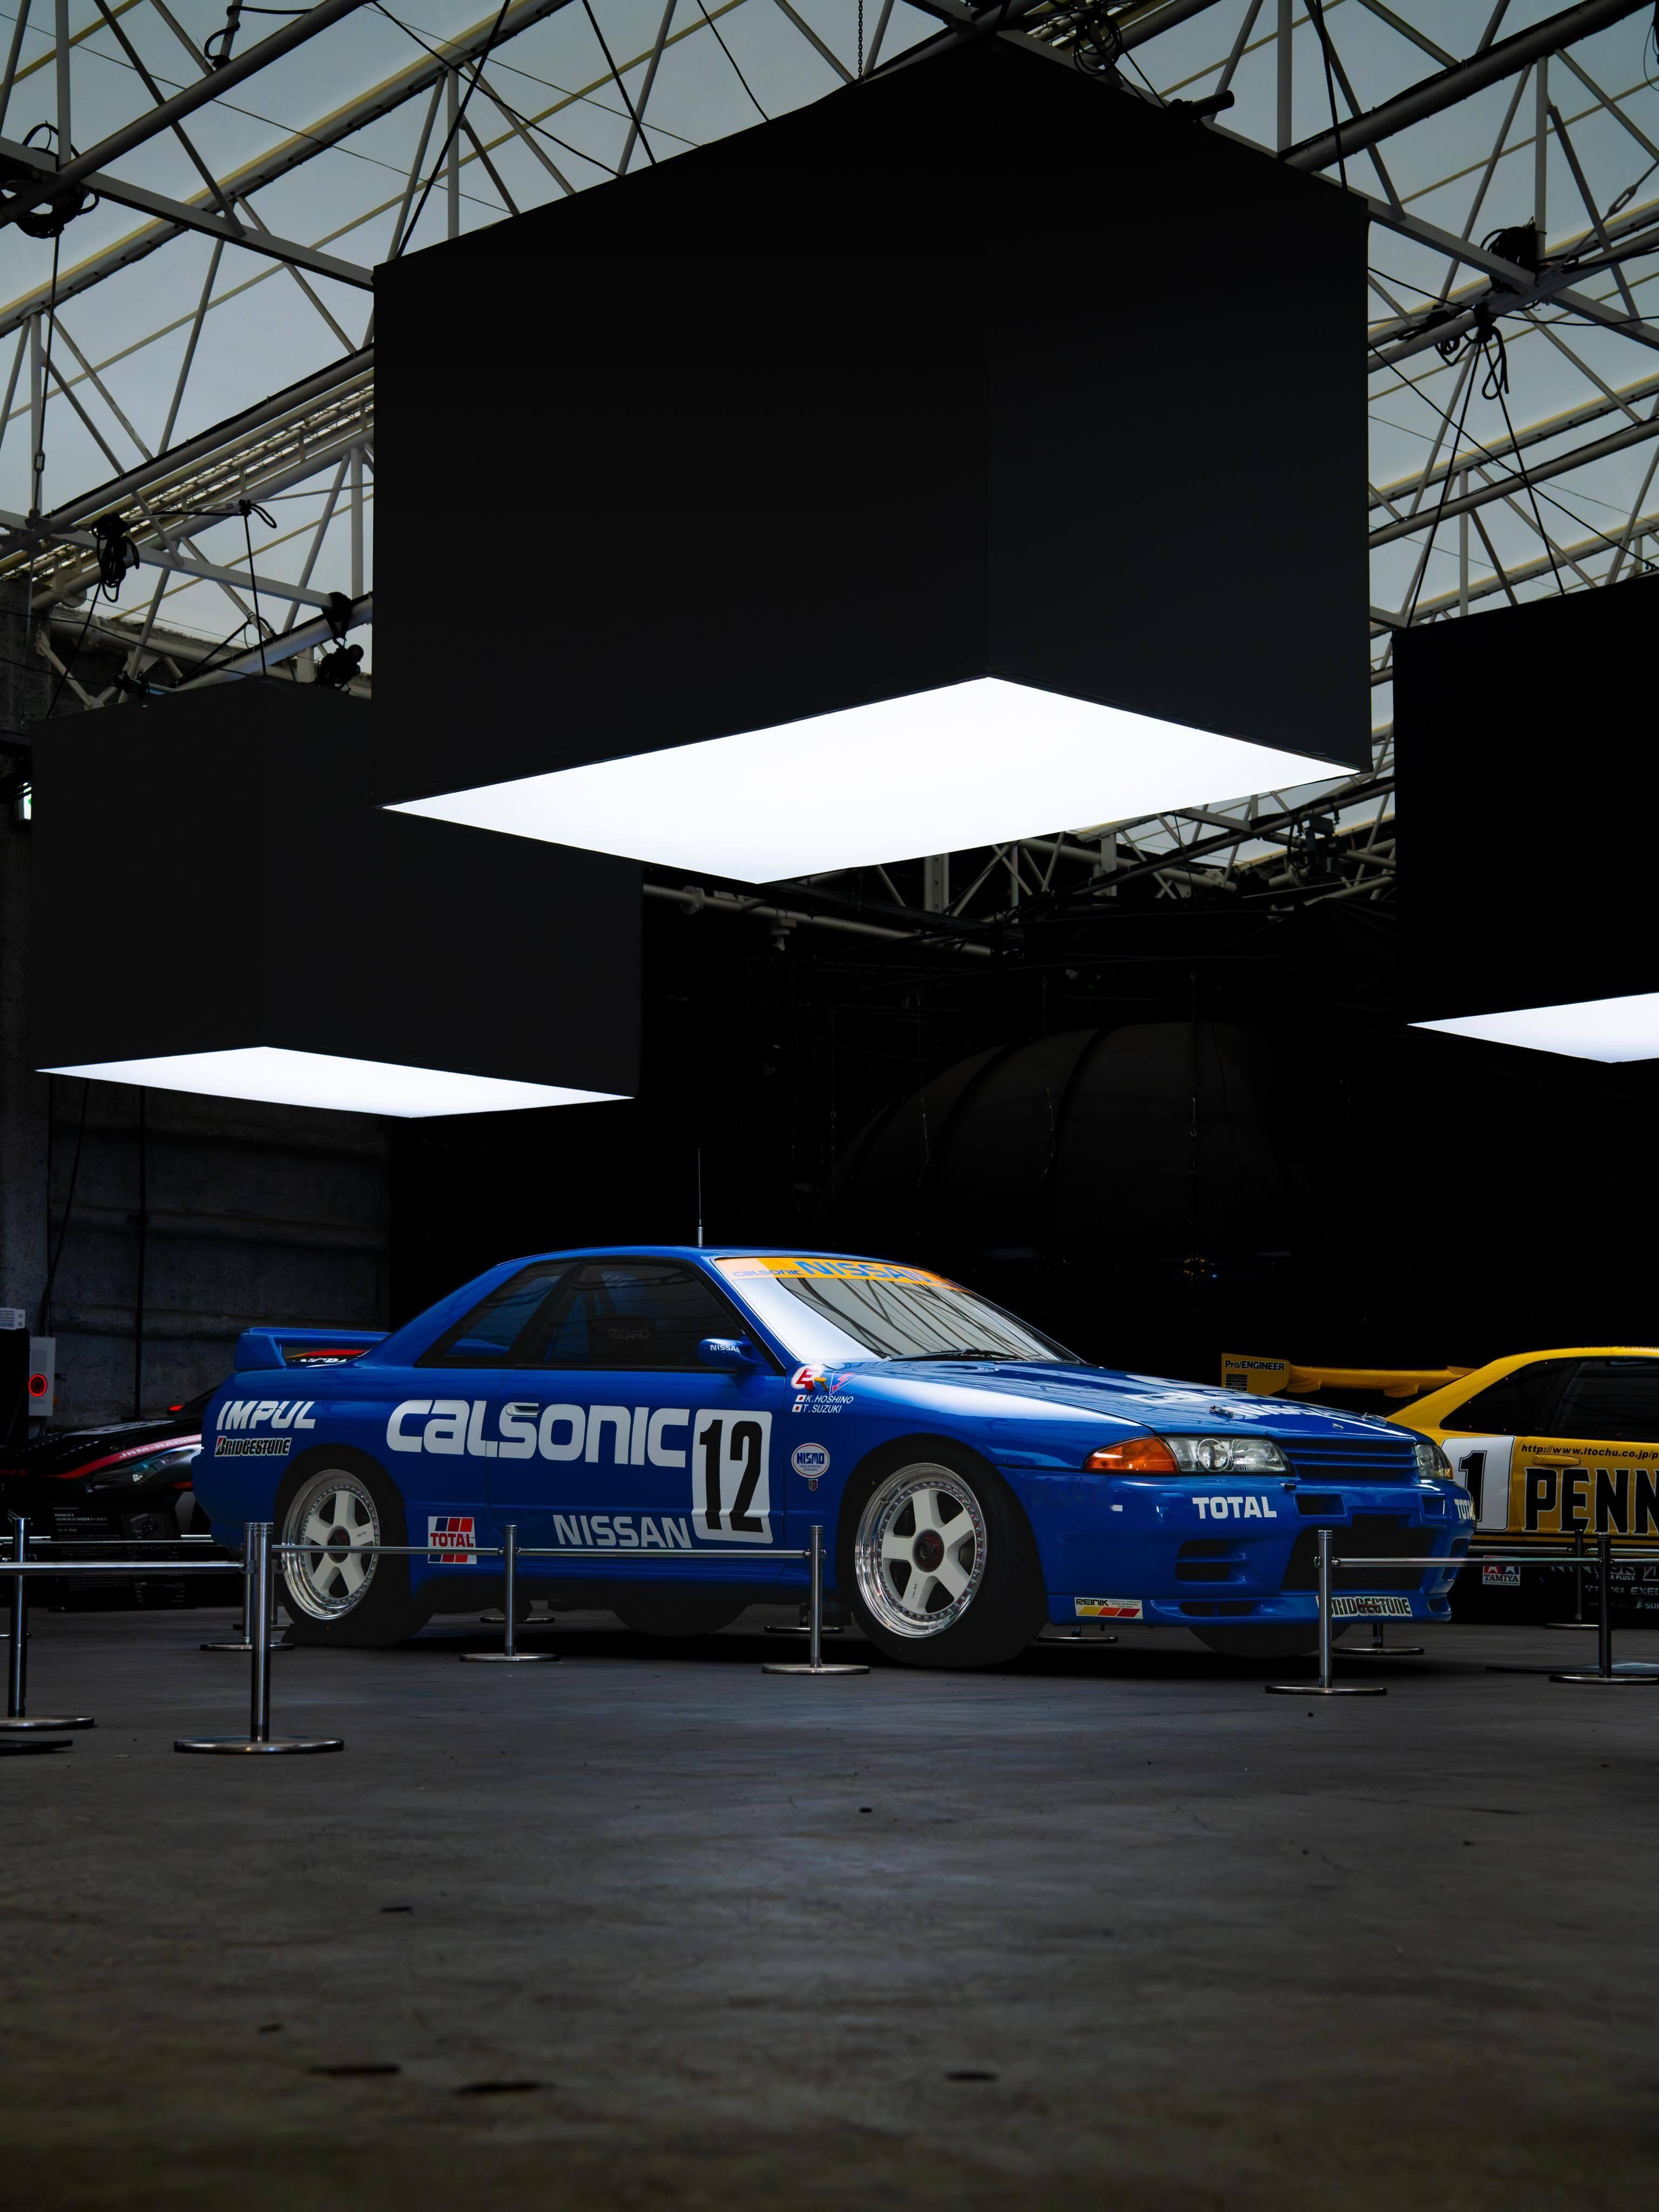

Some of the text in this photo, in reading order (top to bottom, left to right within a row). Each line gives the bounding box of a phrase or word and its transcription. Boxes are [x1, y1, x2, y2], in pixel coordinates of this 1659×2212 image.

[794, 1261, 933, 1283] NISSAN
[608, 1328, 649, 1339] RECARO
[1225, 1360, 1285, 1371] Pro/ENGINEER
[803, 1405, 842, 1413] T.SUZUKI
[805, 1395, 854, 1404] K.HOSHINO
[216, 1400, 316, 1430] IMPUL
[215, 1437, 292, 1456] BRIDGESTONE
[797, 1453, 825, 1464] NISMO
[699, 1419, 763, 1532] 12
[1459, 1451, 1487, 1522] 1
[1192, 1496, 1277, 1519] TOTAL
[1523, 1467, 1659, 1535] PENN
[430, 1533, 474, 1547] TOTAL
[552, 1514, 693, 1549] NISSAN
[1331, 1597, 1412, 1615] RIDGESTONE
